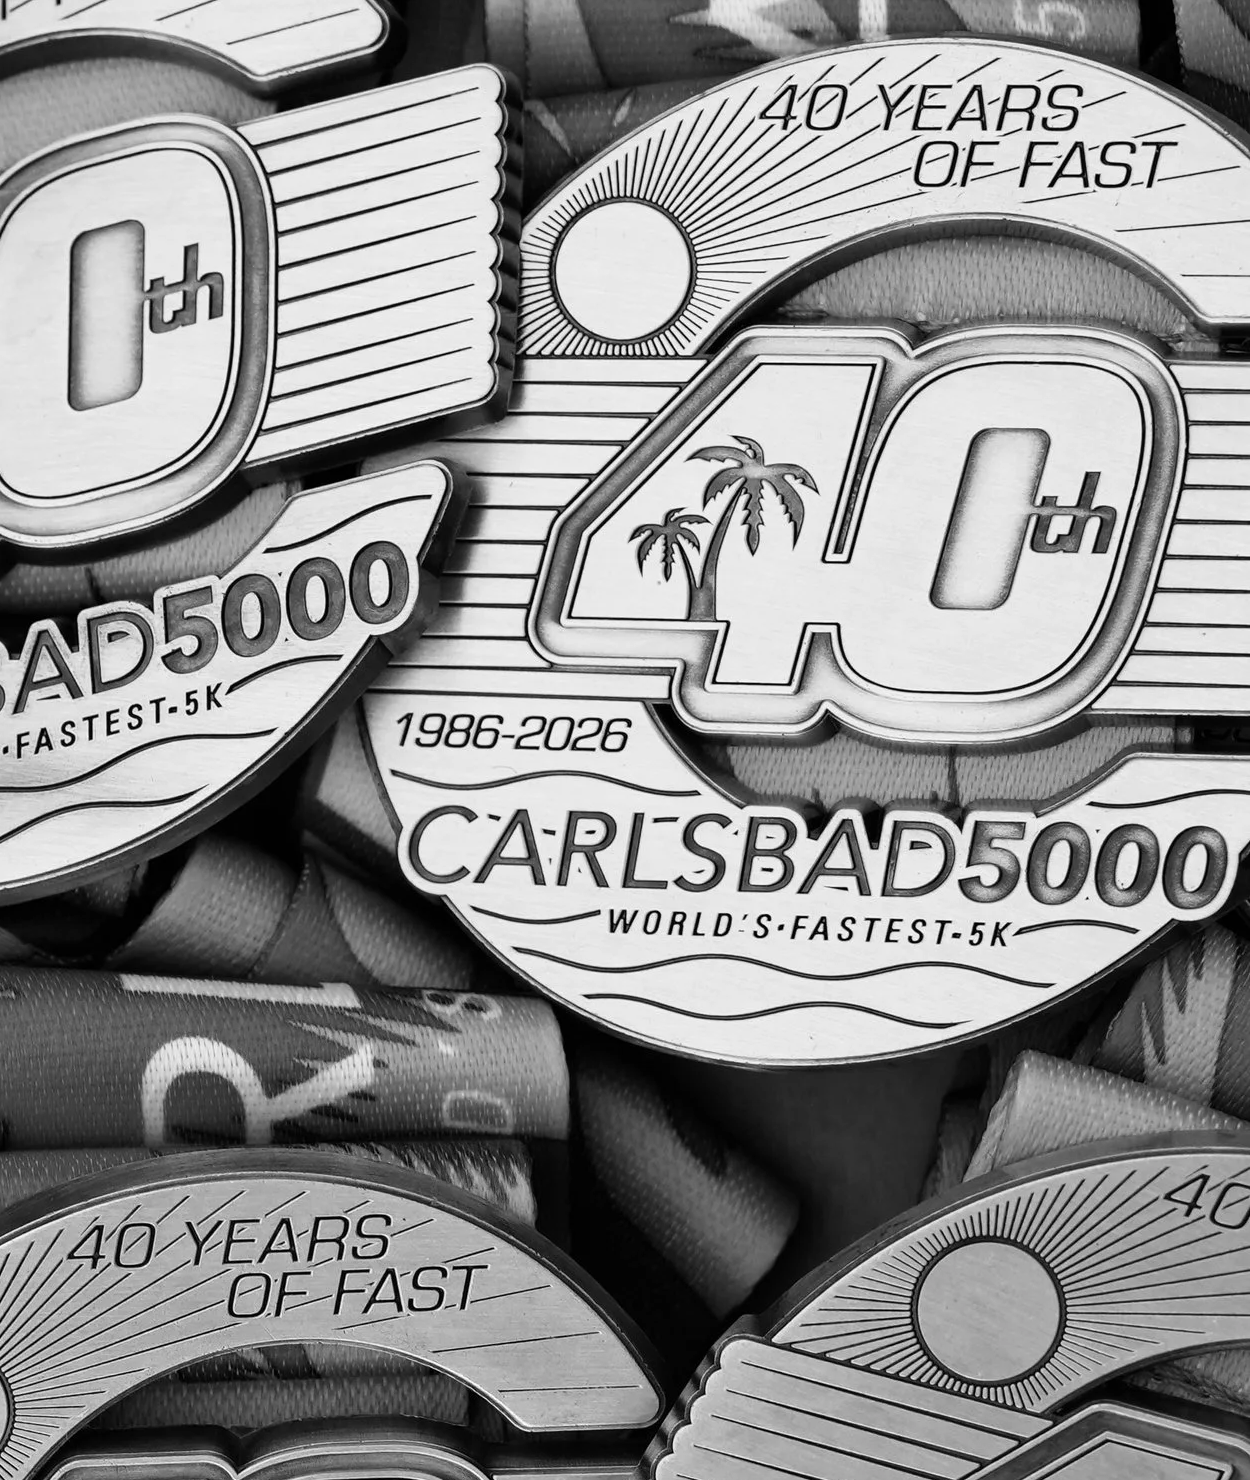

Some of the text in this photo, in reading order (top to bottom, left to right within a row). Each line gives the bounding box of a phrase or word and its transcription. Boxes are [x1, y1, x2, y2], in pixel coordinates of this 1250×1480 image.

[759, 84, 1084, 132] 40 YEARS
[912, 141, 1177, 189] OF FAST
[394, 713, 631, 752] 1986-2026
[67, 1213, 393, 1270] 40 YEARS
[226, 1264, 488, 1318] OF FAST
